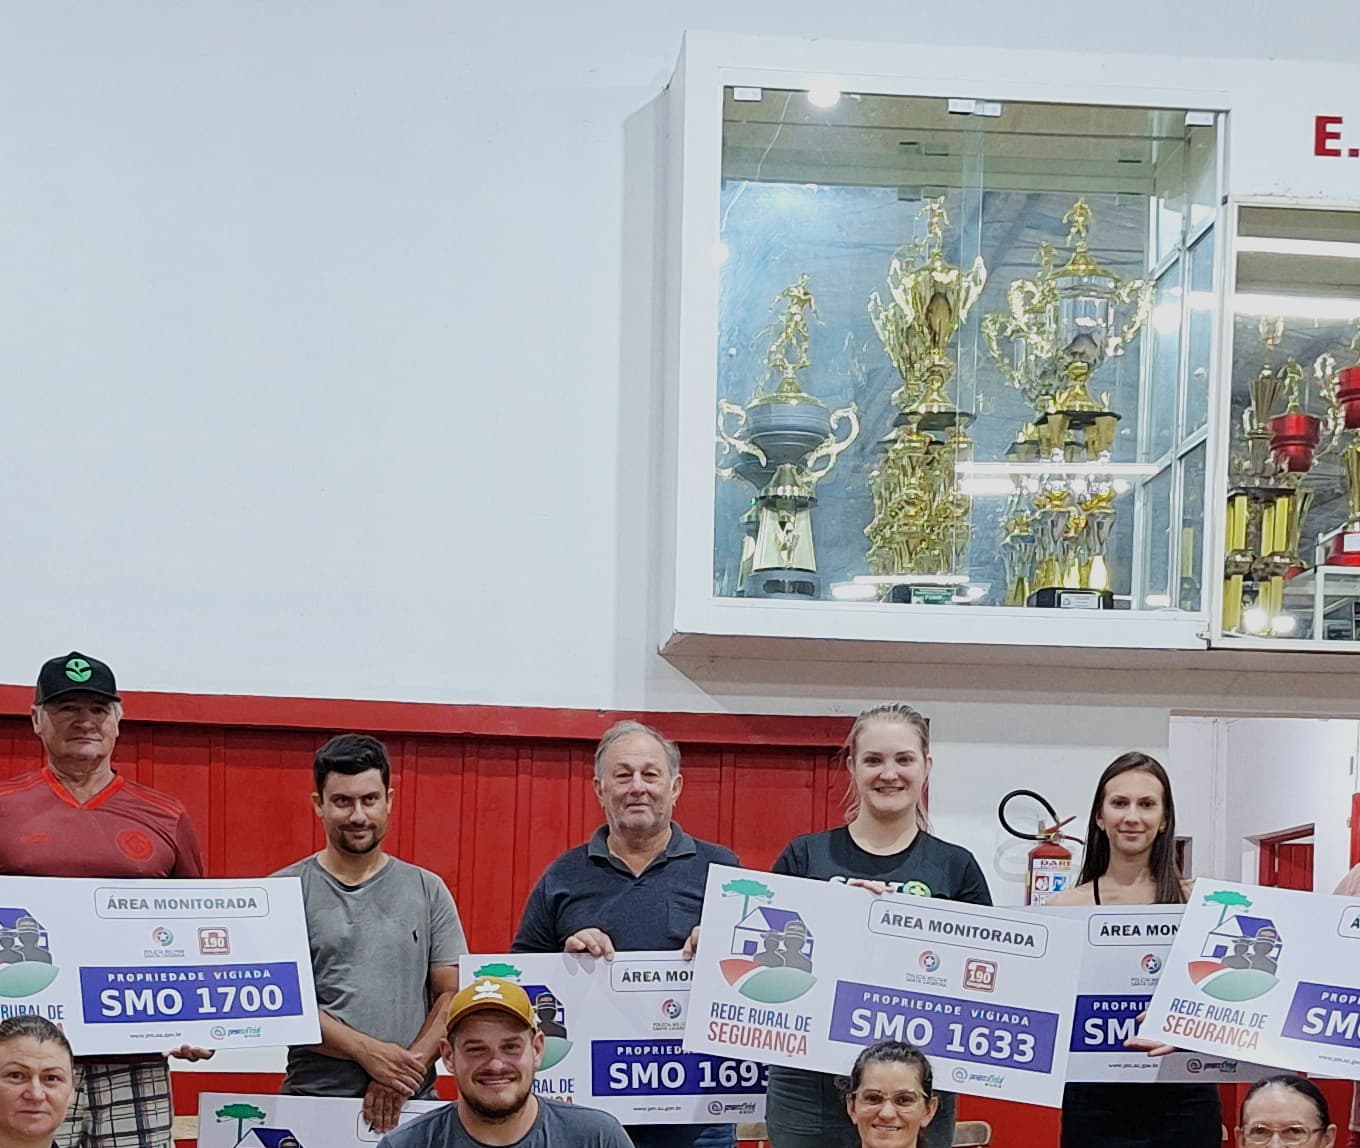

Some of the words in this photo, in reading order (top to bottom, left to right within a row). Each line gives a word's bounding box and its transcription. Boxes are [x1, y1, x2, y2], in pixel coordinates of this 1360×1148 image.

[108, 895, 149, 909] ÁREA
[154, 898, 257, 909] MONITORADA
[881, 910, 923, 930] ÁREA
[928, 920, 1034, 947] MONITORADA
[1100, 922, 1141, 936] ÁREA
[108, 972, 204, 982] PROPRIEDADE
[214, 970, 270, 979] VIGIADA
[622, 969, 661, 982] ÁREA
[969, 970, 991, 984] 190
[48, 1005, 64, 1019] DE
[101, 989, 182, 1016] SMO
[197, 985, 282, 1013] 1700
[864, 992, 960, 1015] PROPRIEDADE
[972, 1009, 1028, 1026] VIGIADA
[1170, 998, 1204, 1017] REDE
[1205, 1005, 1245, 1025] RURAL
[1249, 1013, 1268, 1029] DE
[711, 1002, 745, 1022] REDE
[748, 1008, 790, 1029] RURAL
[795, 1015, 812, 1032] DE
[708, 1021, 806, 1057] SEGURANÇA
[850, 1009, 932, 1046] SMO
[947, 1024, 1034, 1062] 1633
[1085, 1018, 1135, 1045] SM
[618, 1046, 690, 1055] PROPRIED
[560, 1079, 574, 1093] DE
[610, 1062, 684, 1089] SMO
